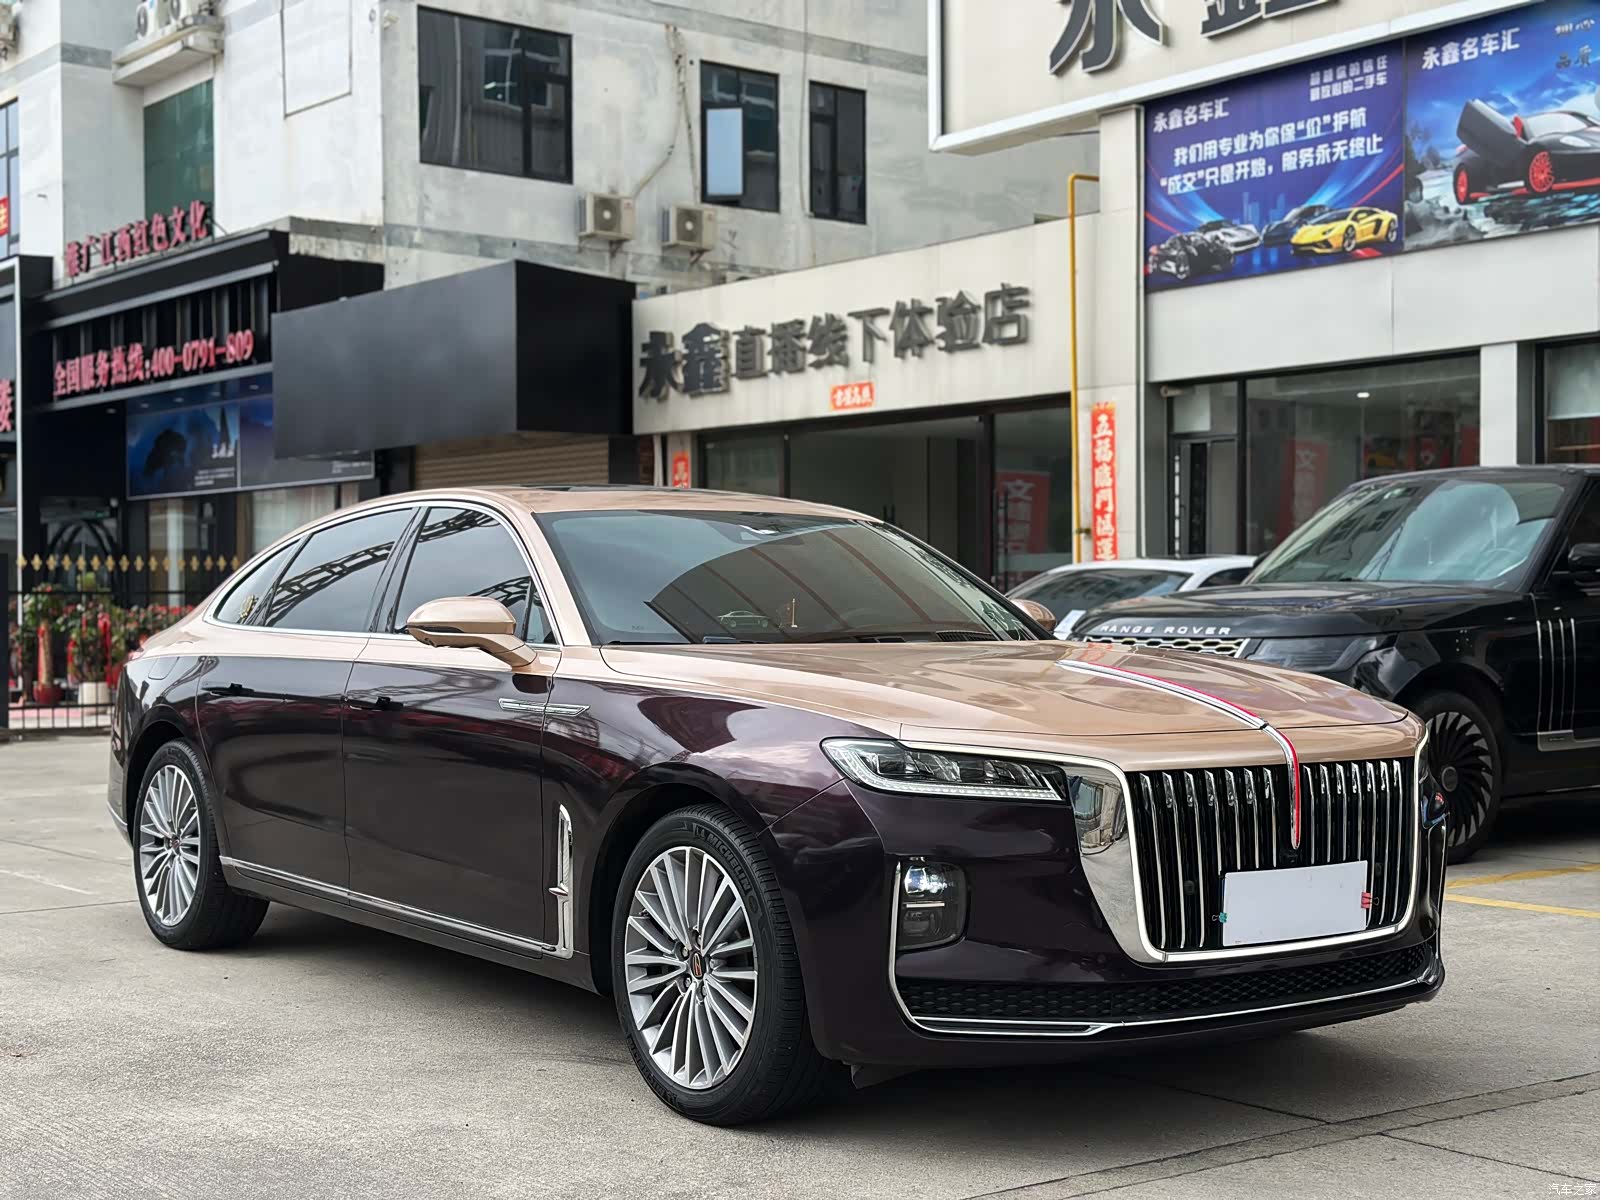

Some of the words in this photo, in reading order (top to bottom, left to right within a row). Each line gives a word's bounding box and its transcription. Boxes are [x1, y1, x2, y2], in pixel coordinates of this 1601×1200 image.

[1421, 28, 1520, 70] 永鑫名车汇
[1153, 97, 1230, 134] 永鑫名车汇
[1101, 625, 1154, 634] RANGE
[1164, 626, 1231, 635] ROVER
[707, 833, 751, 891] MICHELIN
